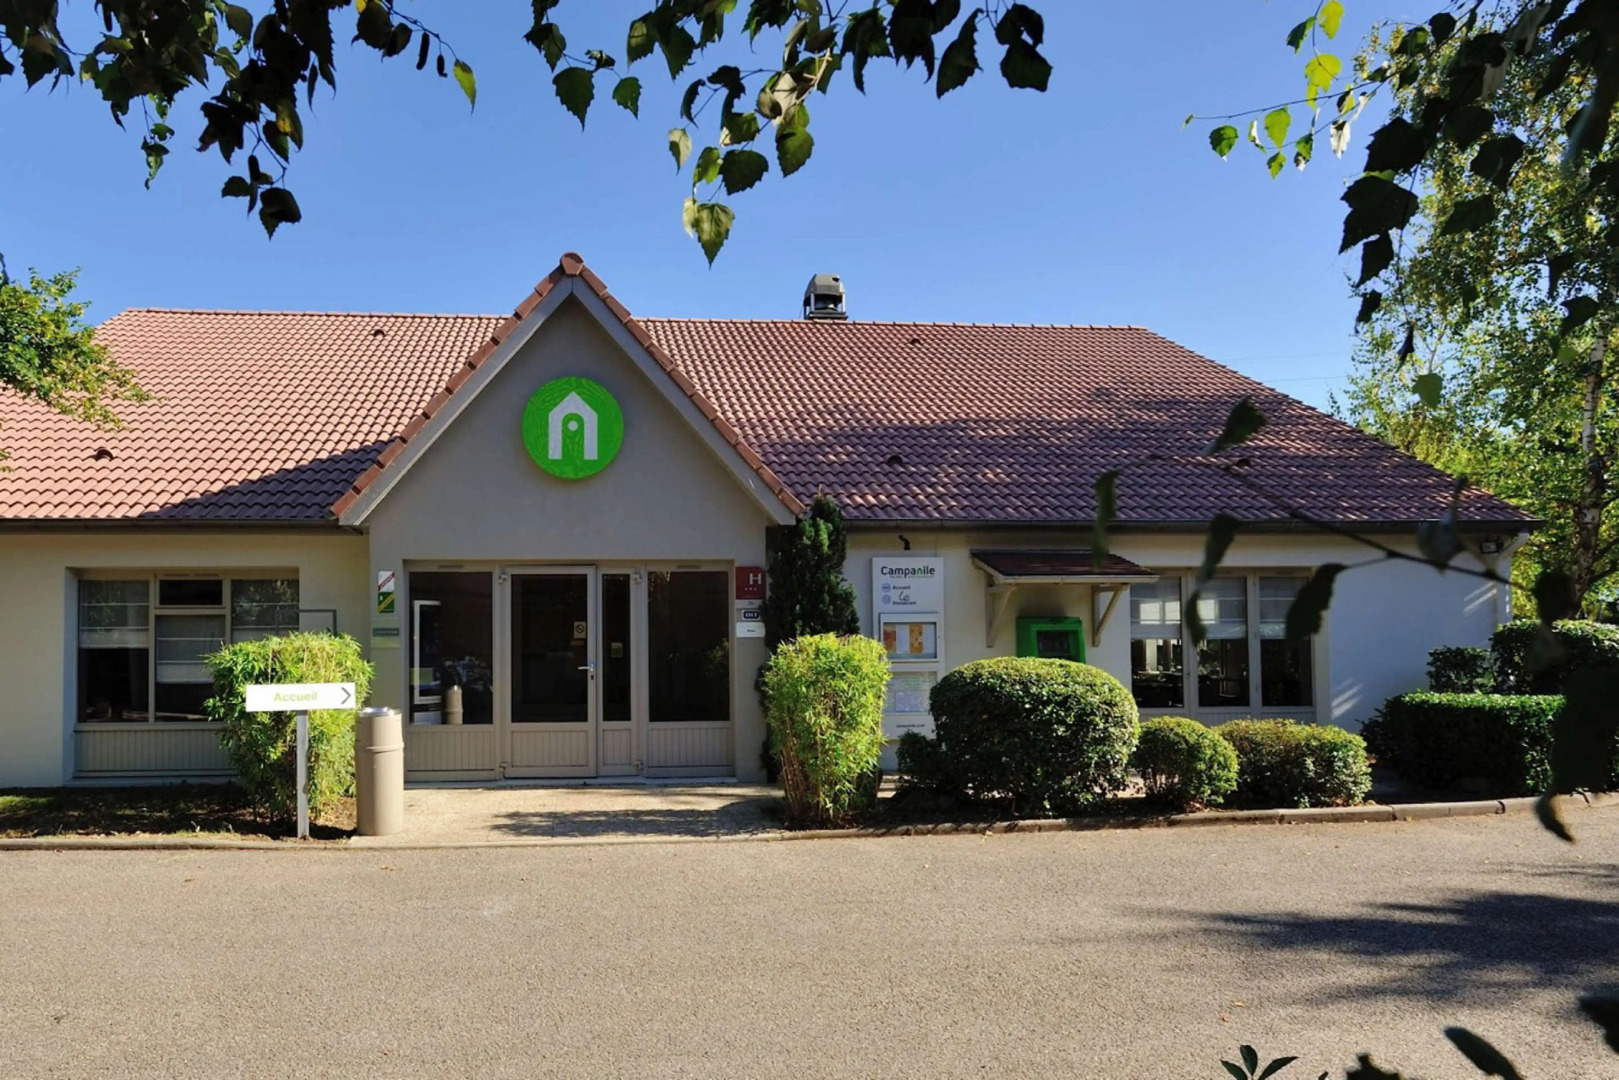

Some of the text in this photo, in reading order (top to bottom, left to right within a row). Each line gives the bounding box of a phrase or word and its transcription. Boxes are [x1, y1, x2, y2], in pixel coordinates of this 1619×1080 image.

[880, 566, 936, 579] Campanile
[749, 573, 762, 585] H
[274, 692, 318, 702] Accueil
